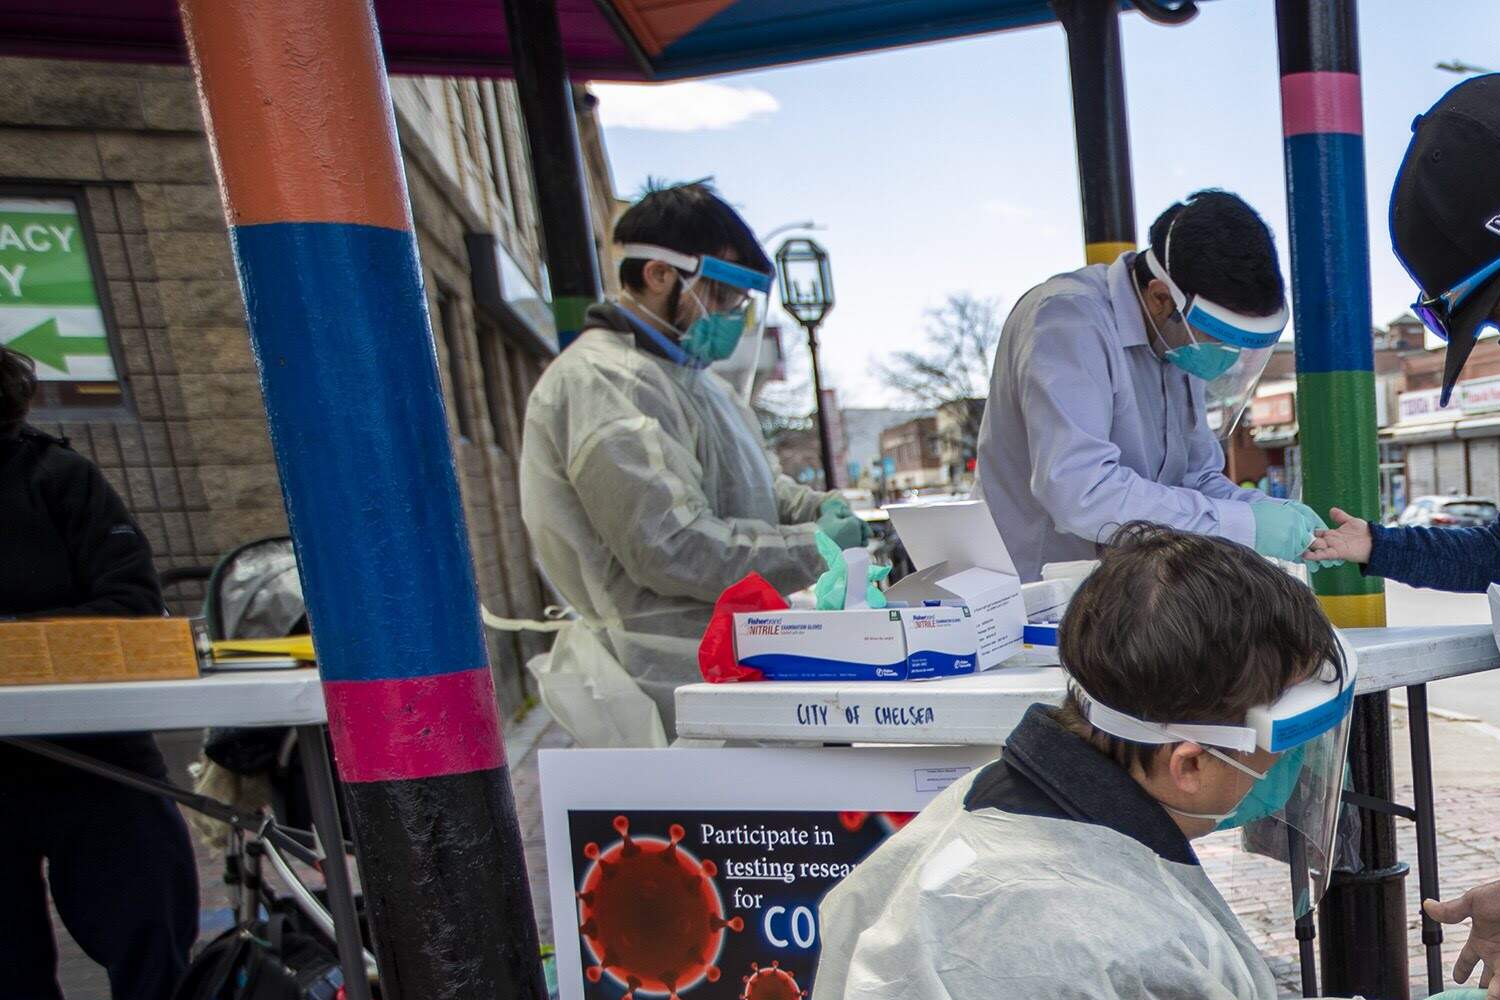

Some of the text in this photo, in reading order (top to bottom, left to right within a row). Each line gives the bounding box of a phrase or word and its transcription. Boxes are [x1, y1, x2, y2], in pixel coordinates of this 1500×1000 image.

[749, 625, 780, 636] NITRILE
[797, 703, 934, 726] CITY OF CHELSEA
[701, 824, 835, 851] Participate in
[725, 857, 796, 884] testing
[734, 887, 763, 909] for
